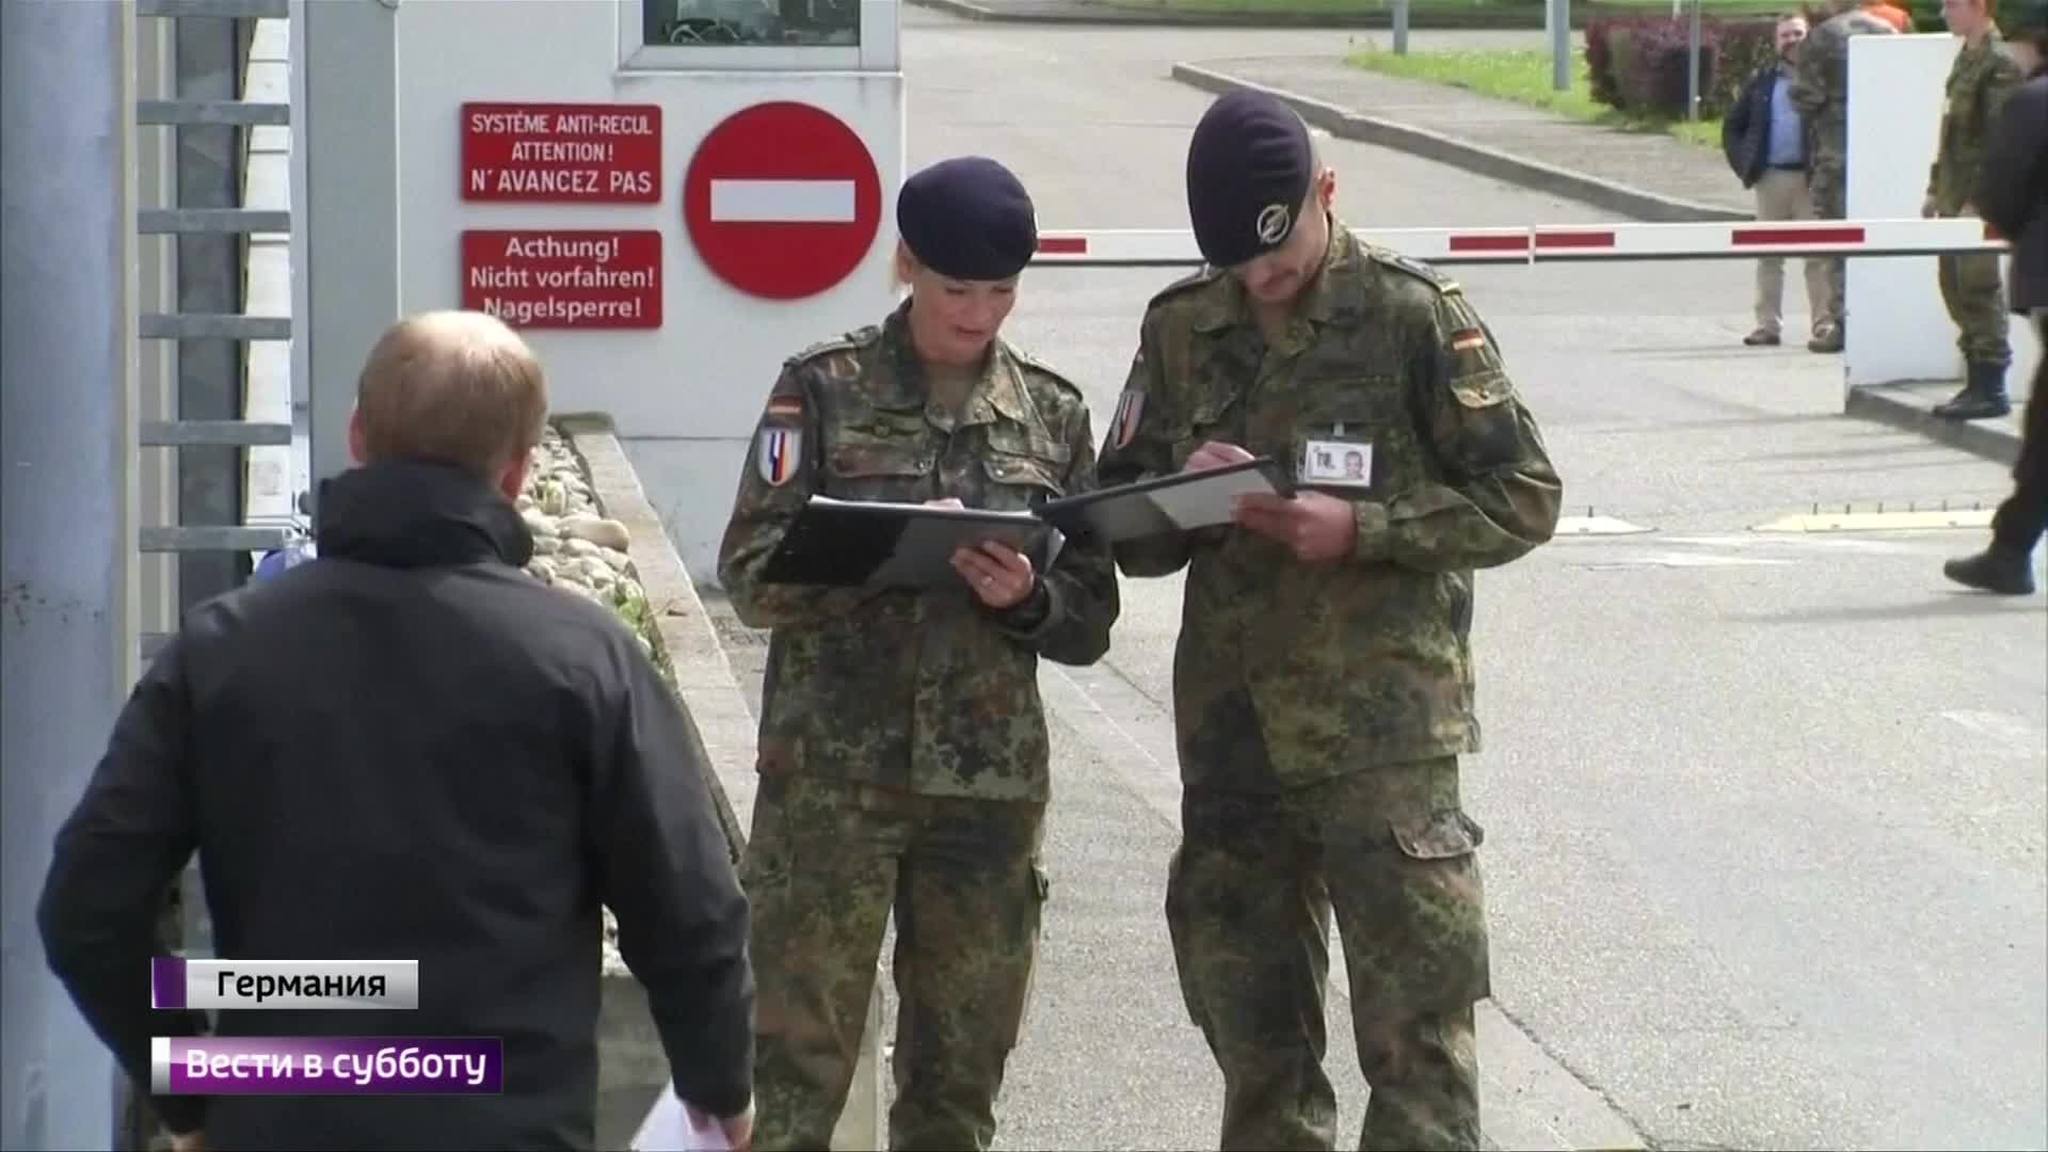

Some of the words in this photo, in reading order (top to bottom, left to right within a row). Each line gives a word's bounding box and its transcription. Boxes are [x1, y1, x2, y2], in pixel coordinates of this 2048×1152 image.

[556, 115, 652, 134] ANTI-RECUL
[610, 170, 652, 193] PAS
[505, 236, 619, 262] Acthung!
[471, 266, 529, 288] Nicht
[536, 265, 654, 288] vorfahren!
[484, 296, 641, 323] Nagelsperre!
